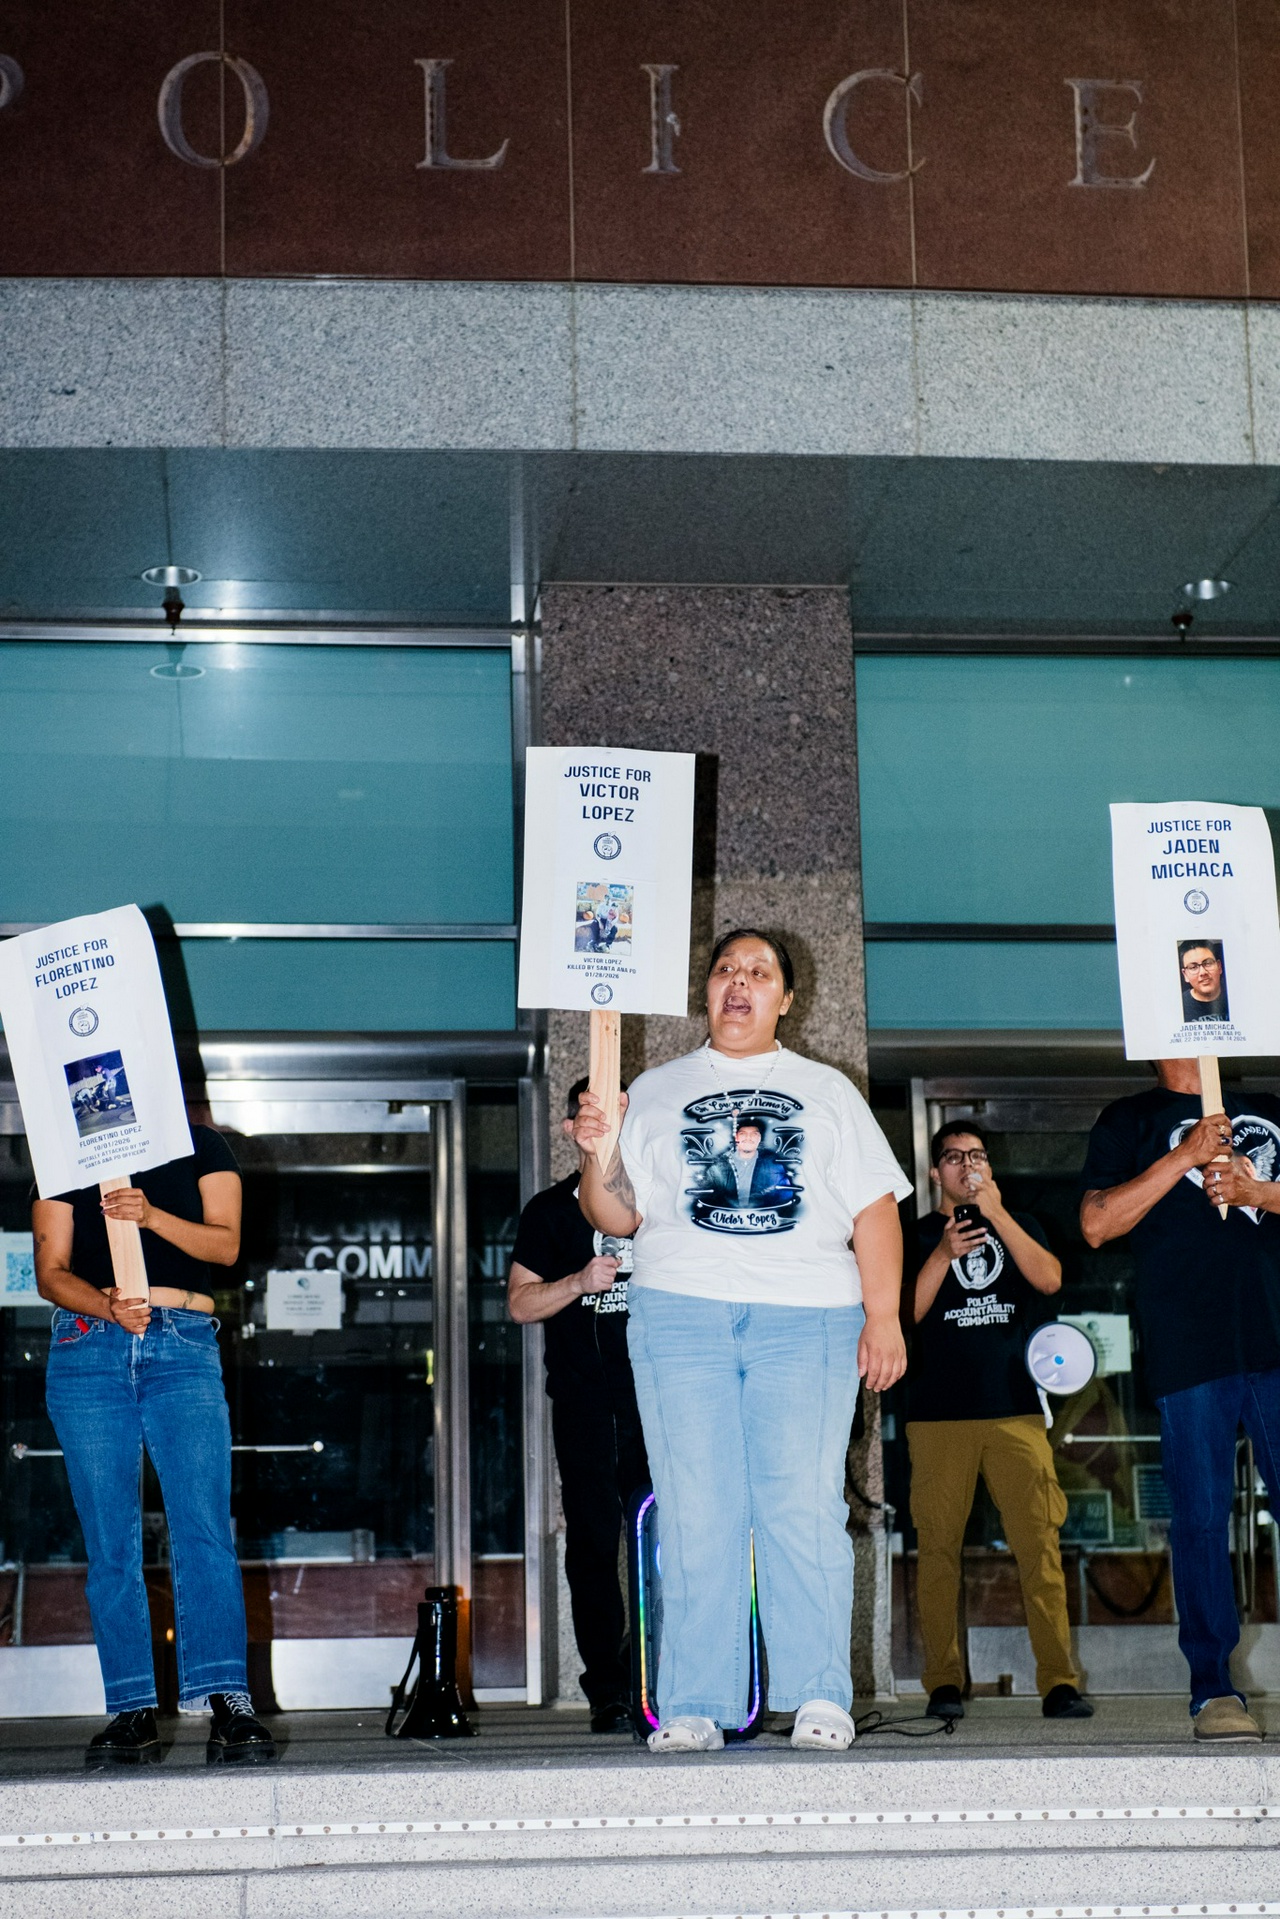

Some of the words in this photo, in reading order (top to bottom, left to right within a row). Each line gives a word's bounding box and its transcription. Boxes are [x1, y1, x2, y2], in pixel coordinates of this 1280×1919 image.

[564, 765, 621, 780] JUSTICE
[626, 769, 651, 782] FOR
[579, 783, 640, 801] VICTOR
[582, 805, 635, 822] LOPEZ
[1147, 819, 1202, 834] JUSTICE
[1206, 819, 1232, 832] FOR
[1162, 838, 1220, 855] JADEN
[1151, 862, 1234, 880] MICHACA
[35, 944, 80, 969] JUSTICE
[84, 938, 109, 953] FOR
[35, 954, 115, 988] FLORENTINO
[55, 976, 99, 999] LOPEZ
[1180, 1024, 1203, 1032] JADEN
[1204, 1023, 1235, 1031] MICHACA
[709, 1100, 744, 1111] Lovng
[747, 1097, 791, 1114] Memory
[79, 1131, 119, 1148] FLORENTINO
[120, 1125, 142, 1136] LOPEZ
[1239, 1125, 1270, 1138] JADEN
[85, 1159, 101, 1169] SANTA
[102, 1156, 113, 1164] ANA
[122, 1148, 147, 1158] OFFICERS
[101, 1145, 129, 1157] ATTACKED
[712, 1211, 744, 1225] Victor
[746, 1212, 777, 1228] Lopez
[966, 1293, 998, 1307] POLICE
[944, 1303, 1016, 1321] ACCOUNTABILITY
[957, 1313, 1010, 1328] COMMITTEE
